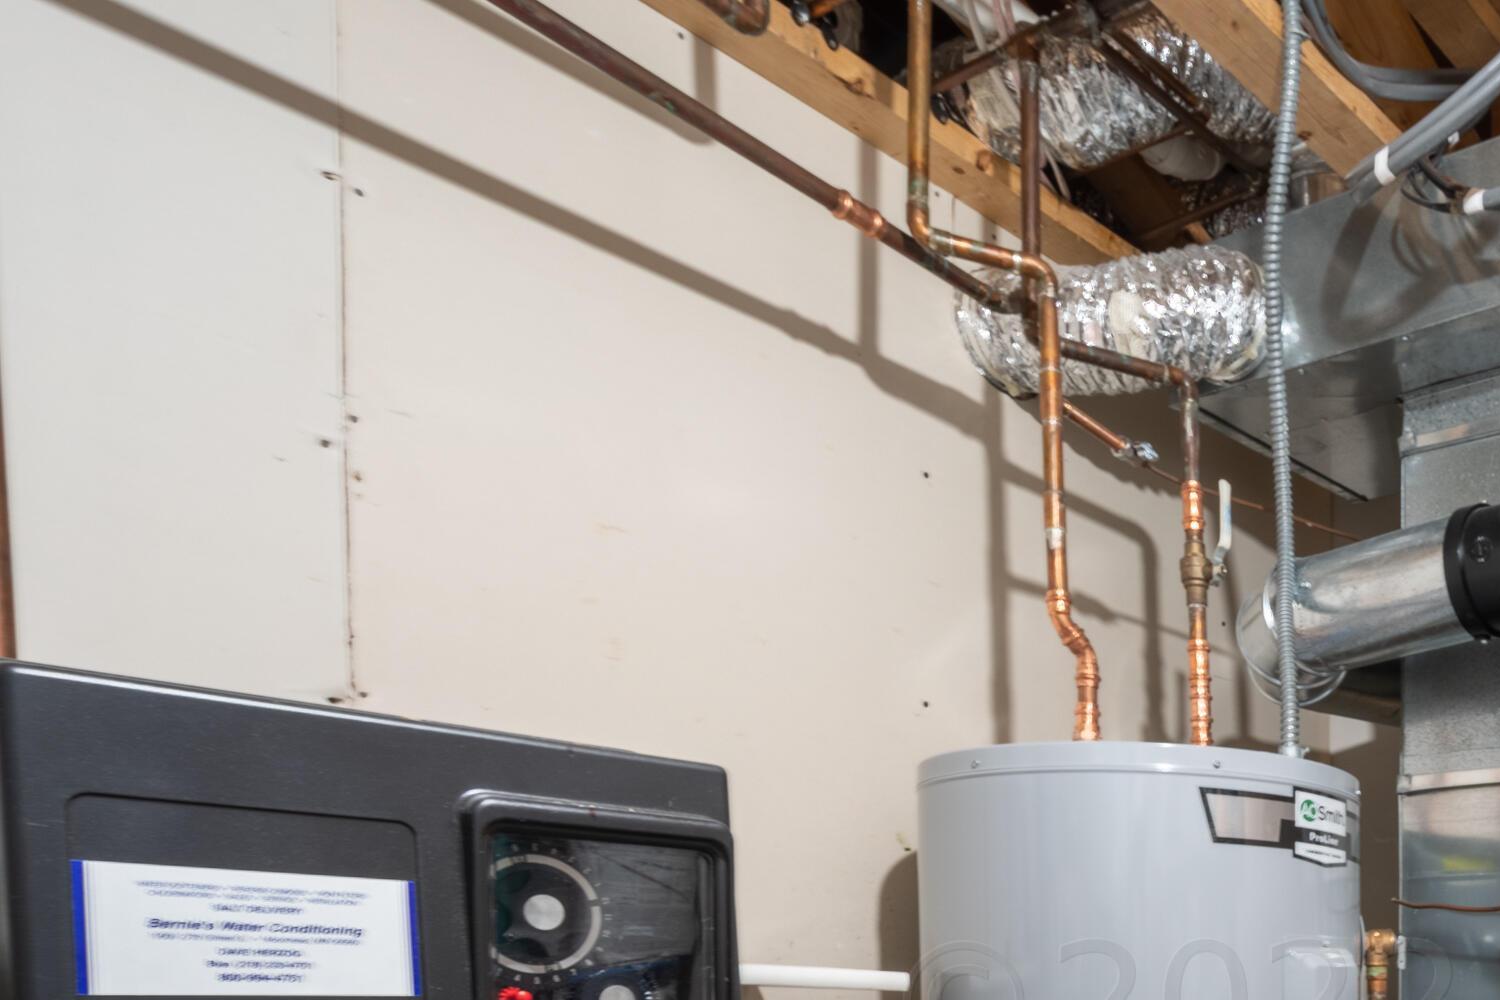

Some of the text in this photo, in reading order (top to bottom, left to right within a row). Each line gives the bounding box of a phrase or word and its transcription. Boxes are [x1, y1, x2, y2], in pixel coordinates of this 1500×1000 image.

[146, 917, 215, 930] Bernie's
[221, 920, 265, 932] Water
[268, 923, 363, 939] Conditioning
